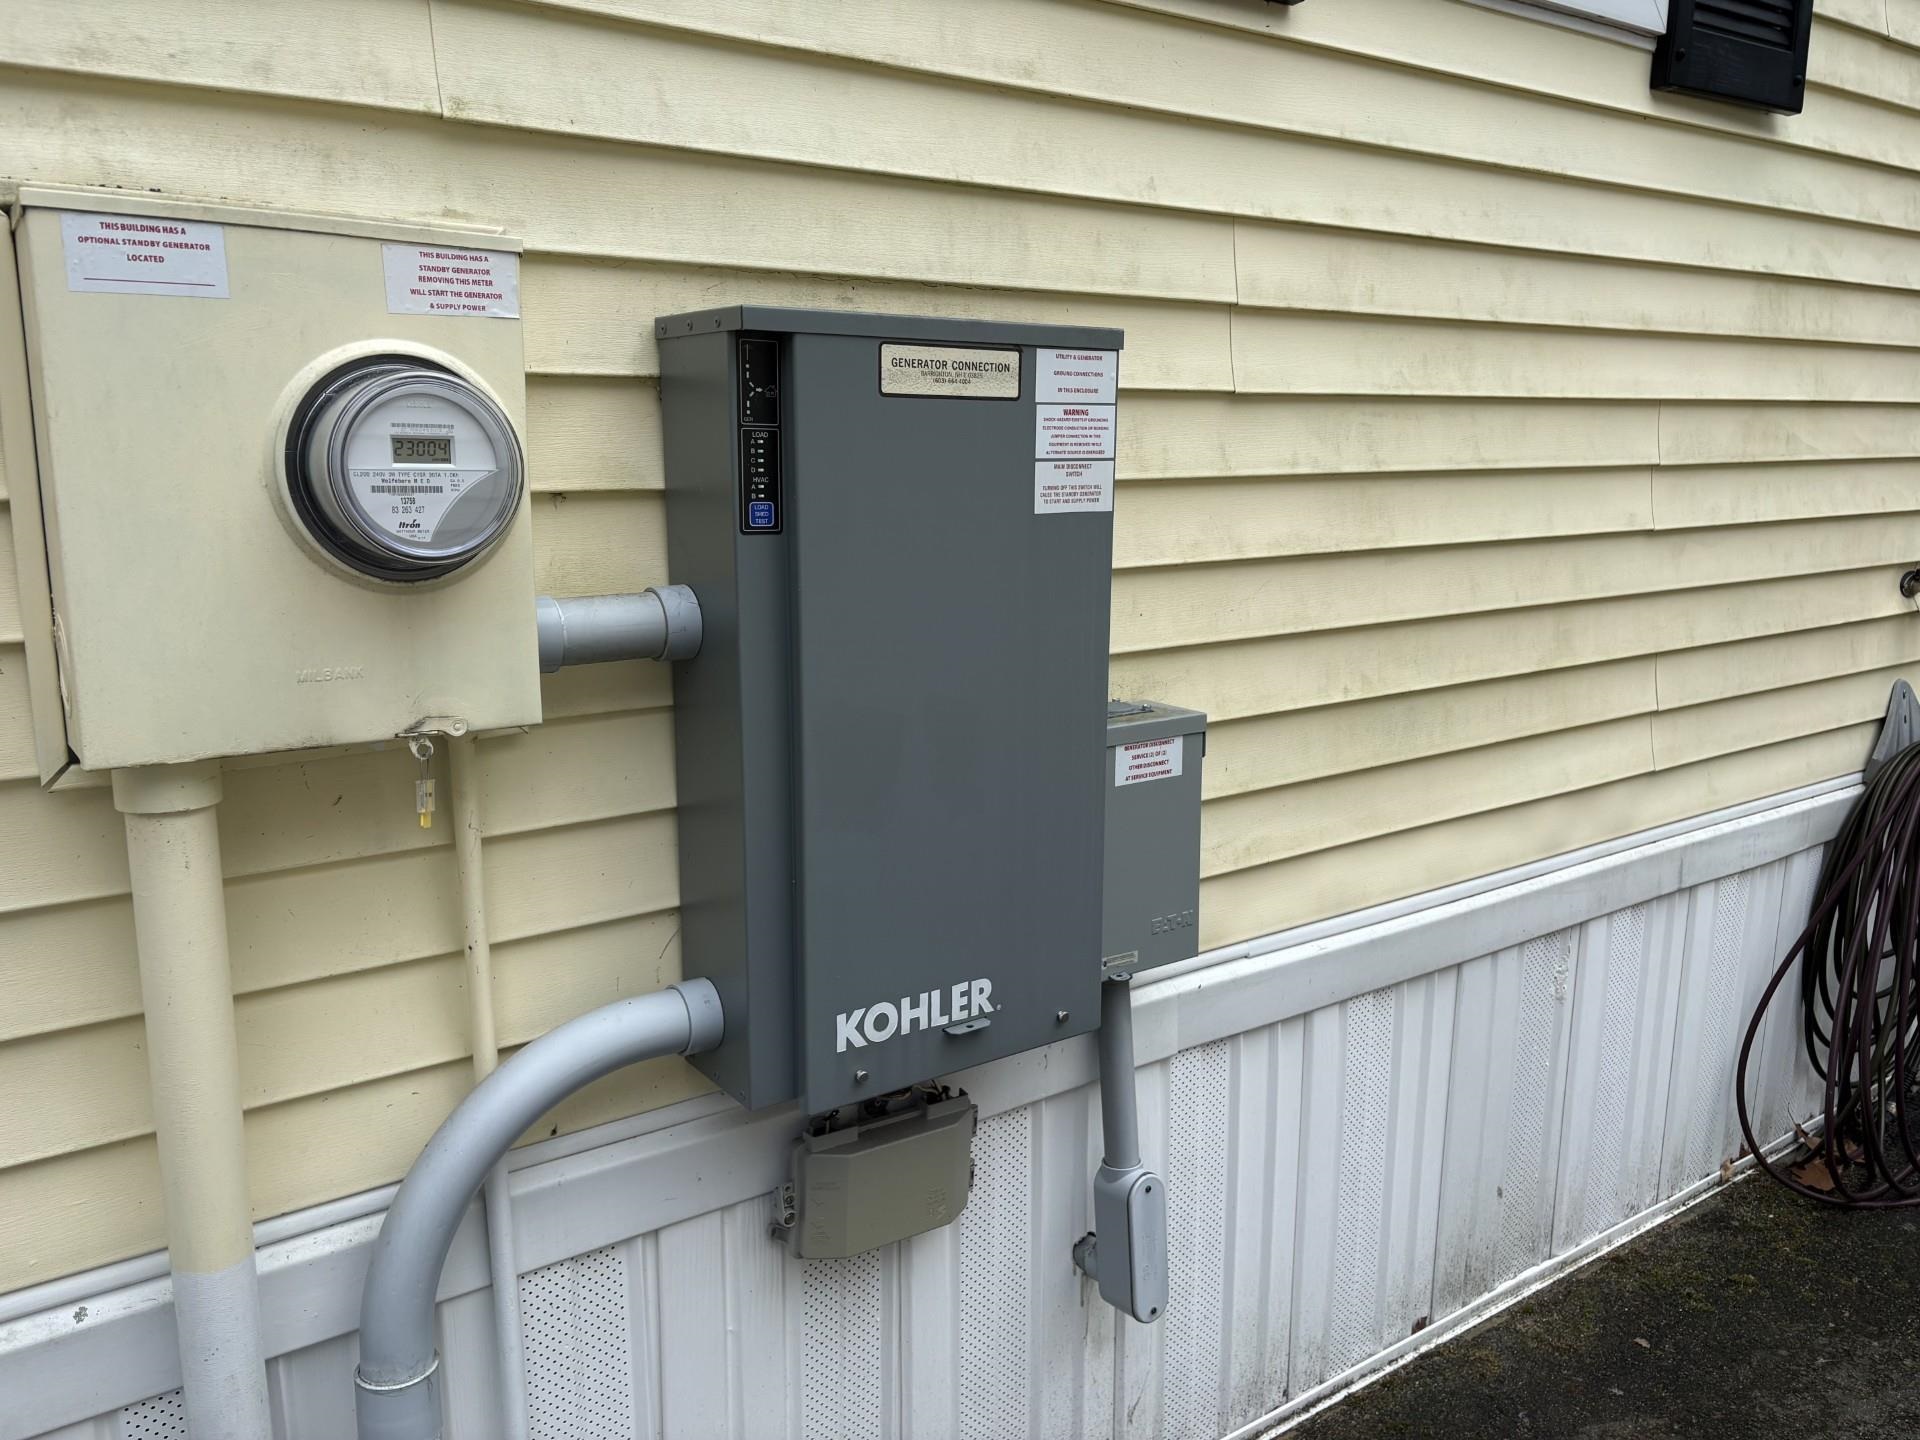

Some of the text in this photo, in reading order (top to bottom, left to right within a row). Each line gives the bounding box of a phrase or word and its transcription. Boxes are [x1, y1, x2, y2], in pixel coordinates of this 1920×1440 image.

[100, 222, 186, 235] THIS BUILDING HAS A
[78, 236, 210, 251] OPTIONAL STANDBY GENERATOR
[126, 254, 165, 263] LOCATED
[436, 252, 468, 261] BUILDING
[452, 267, 491, 275] GENERATOR
[418, 275, 454, 284] REMOVING
[464, 292, 503, 300] GENERATOR
[891, 357, 1010, 373] GENERATOR CONNECTION
[394, 440, 447, 457] 23004
[399, 519, 420, 528] Itron
[296, 665, 364, 682] MILBANK
[1124, 739, 1175, 751] GENERATOR DISCONNECT
[1143, 760, 1169, 768] DISCONNECT
[1131, 772, 1148, 781] SERVICE
[1149, 769, 1172, 777] EQUIPMENT
[836, 978, 994, 1053] KOHLER
